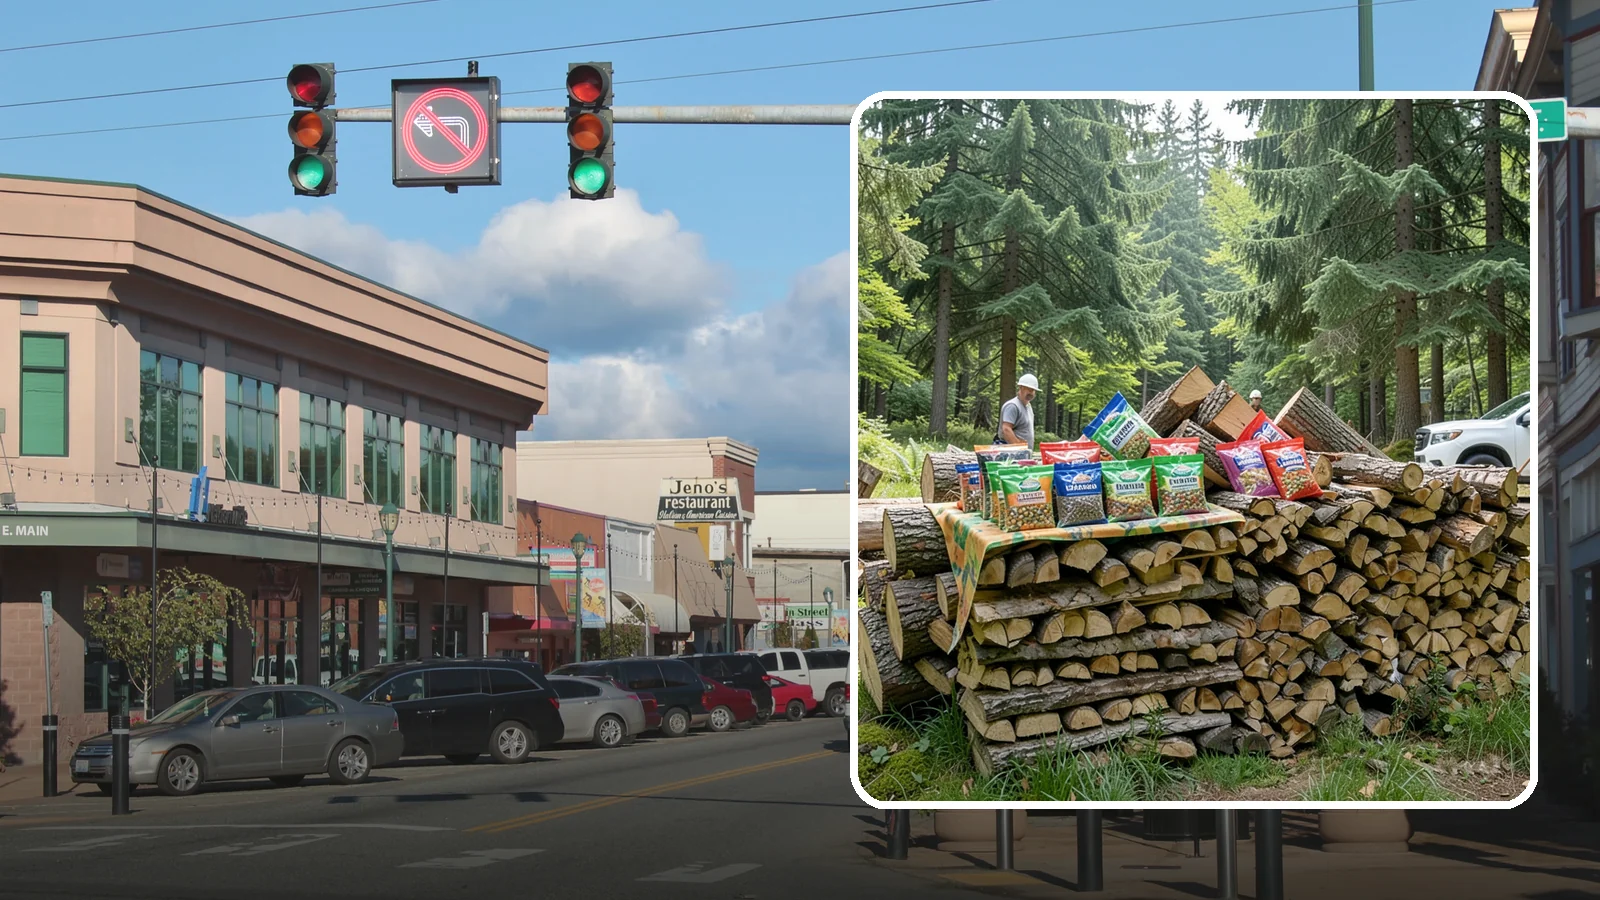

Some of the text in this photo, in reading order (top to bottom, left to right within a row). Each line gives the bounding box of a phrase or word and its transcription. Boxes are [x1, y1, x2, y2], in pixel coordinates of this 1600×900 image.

[669, 480, 727, 494] Jeno's
[665, 496, 731, 509] restaurant
[659, 509, 681, 519] Italian
[686, 509, 714, 519] American
[715, 509, 737, 519] Cuisine
[2, 525, 49, 536] E. MAIN
[797, 607, 828, 616] Street
